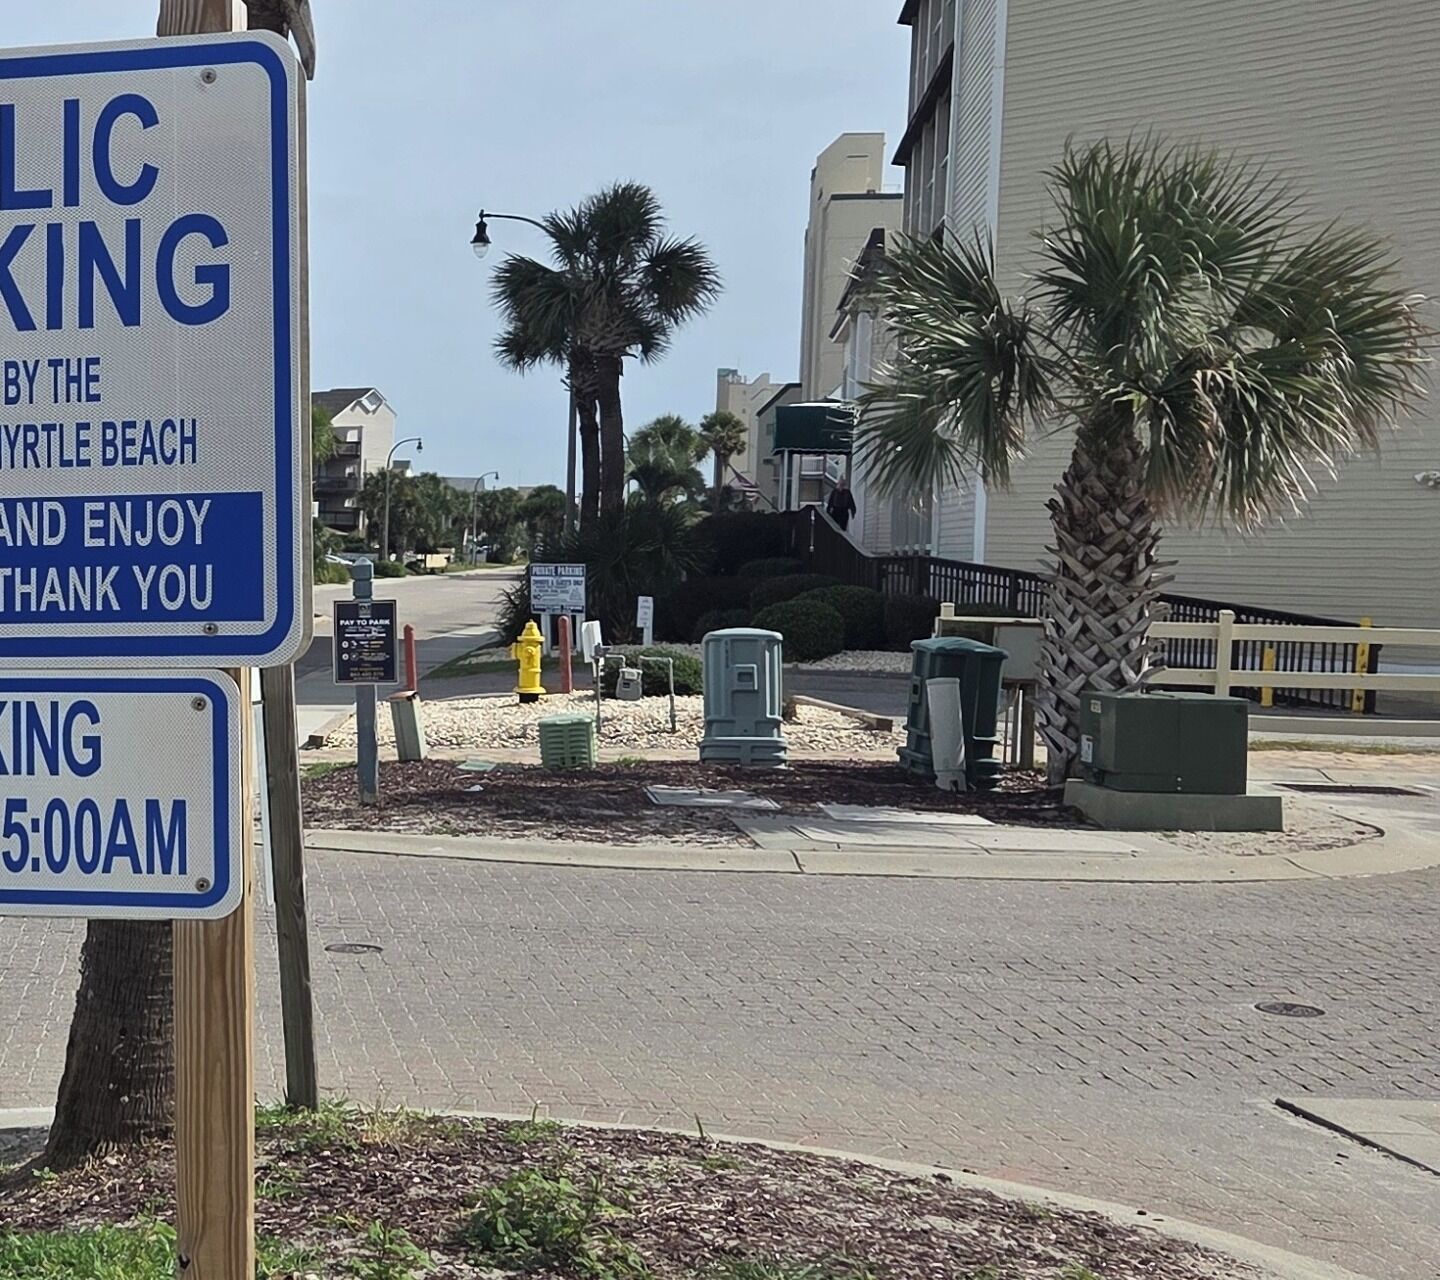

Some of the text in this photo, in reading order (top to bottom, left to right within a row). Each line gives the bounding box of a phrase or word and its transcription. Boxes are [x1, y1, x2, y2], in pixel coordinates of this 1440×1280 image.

[3, 359, 41, 406] BY
[47, 356, 102, 403] THE
[100, 417, 198, 468] BEACH
[83, 499, 212, 548] ENJOY
[131, 563, 214, 612] YOU
[2, 797, 188, 875] 5:00AM
